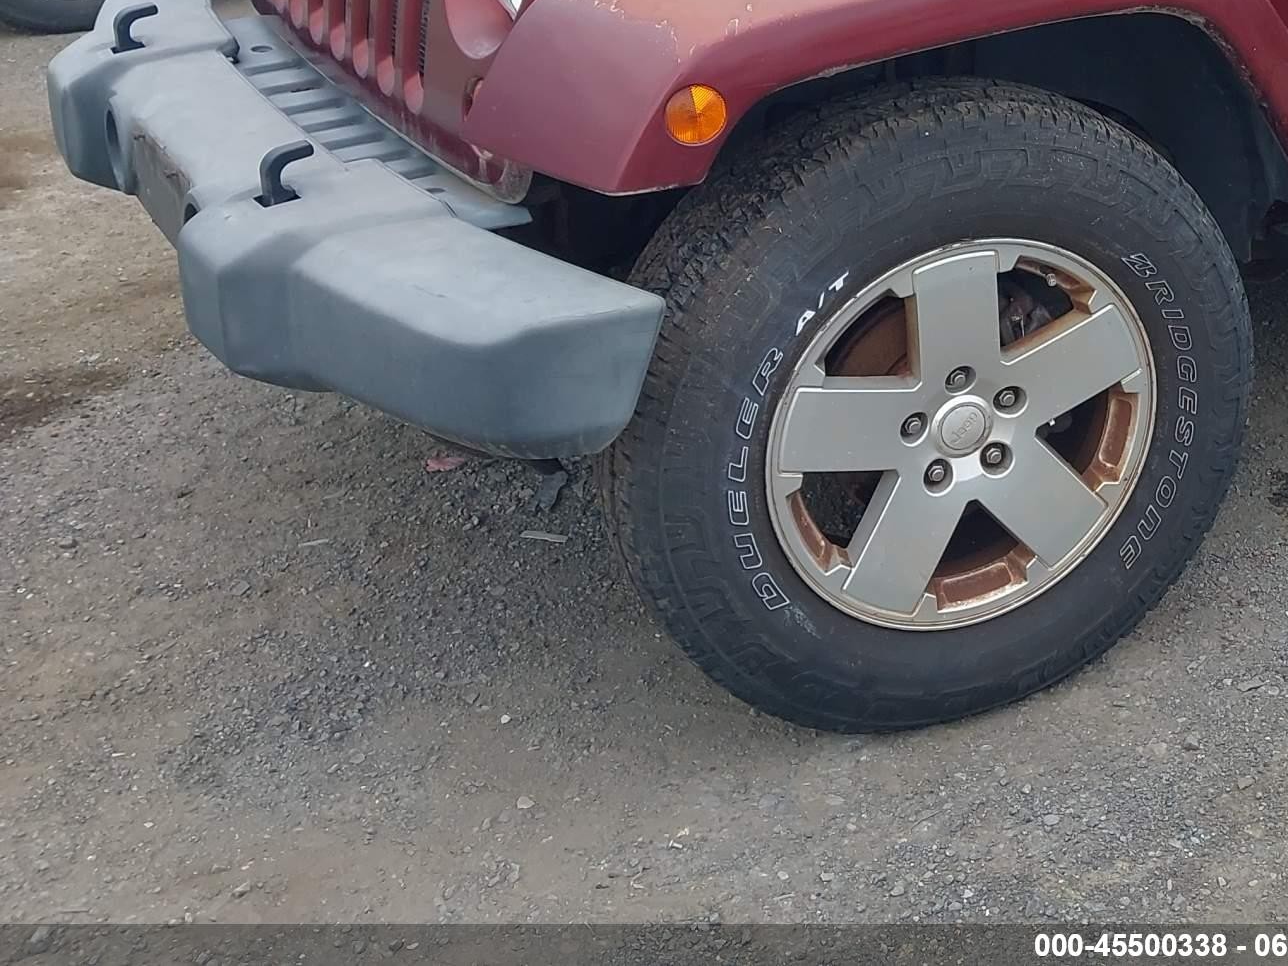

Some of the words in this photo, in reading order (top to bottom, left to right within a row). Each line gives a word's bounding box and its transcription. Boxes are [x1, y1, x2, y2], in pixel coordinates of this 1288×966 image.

[726, 347, 790, 611] DUELER
[794, 271, 851, 337] A/T
[1120, 252, 1199, 570] BRIDGESTONE
